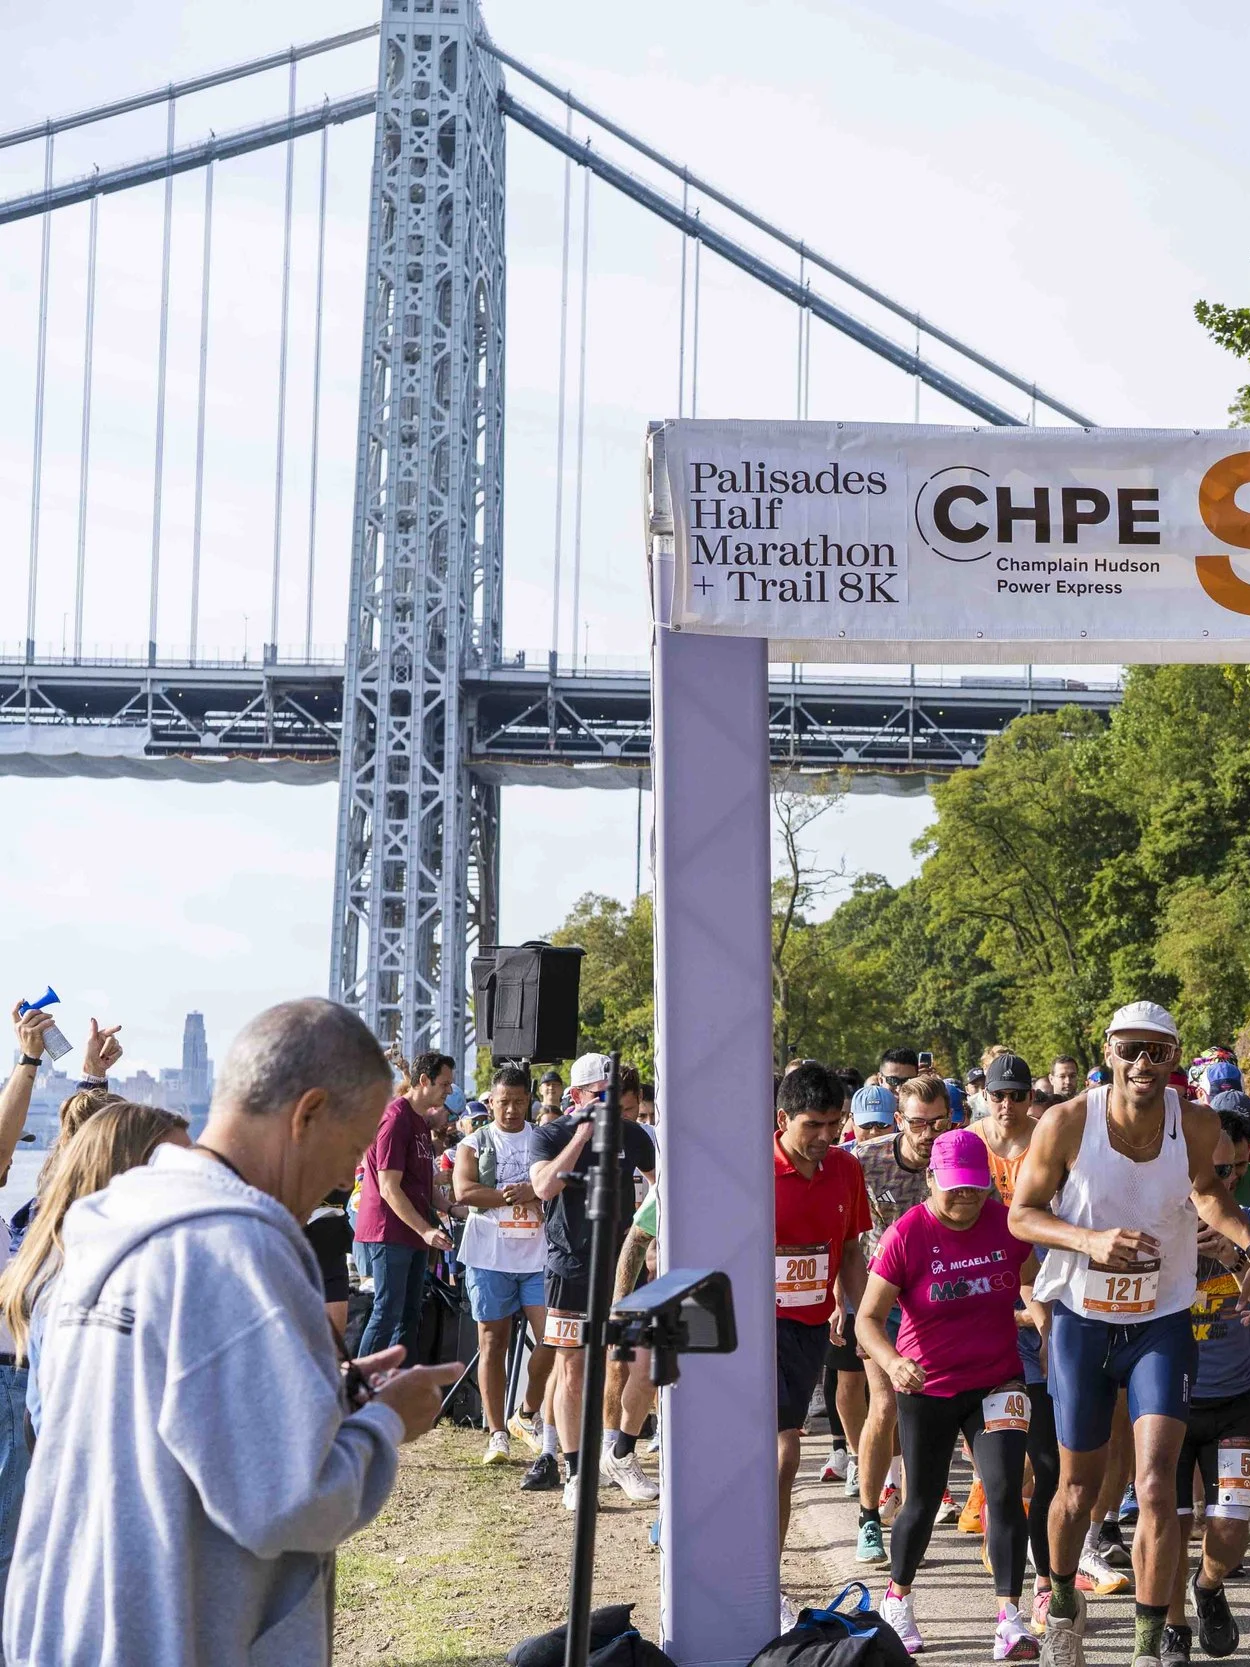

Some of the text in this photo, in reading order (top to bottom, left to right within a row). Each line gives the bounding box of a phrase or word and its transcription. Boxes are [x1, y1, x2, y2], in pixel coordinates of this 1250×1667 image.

[690, 461, 887, 495] Palisades
[690, 497, 783, 530] Half
[933, 484, 1161, 545] CHPE
[691, 534, 898, 567] Marathon
[996, 557, 1160, 575] Champlain Hudson
[727, 570, 829, 602] Trail
[838, 572, 900, 603] 8K
[997, 579, 1123, 597] Power Express
[513, 1205, 528, 1220] 84
[786, 1258, 817, 1281] 200
[950, 1255, 991, 1270] MICAELA
[1105, 1276, 1143, 1301] 121
[555, 1320, 578, 1339] 176
[1004, 1394, 1025, 1418] 49
